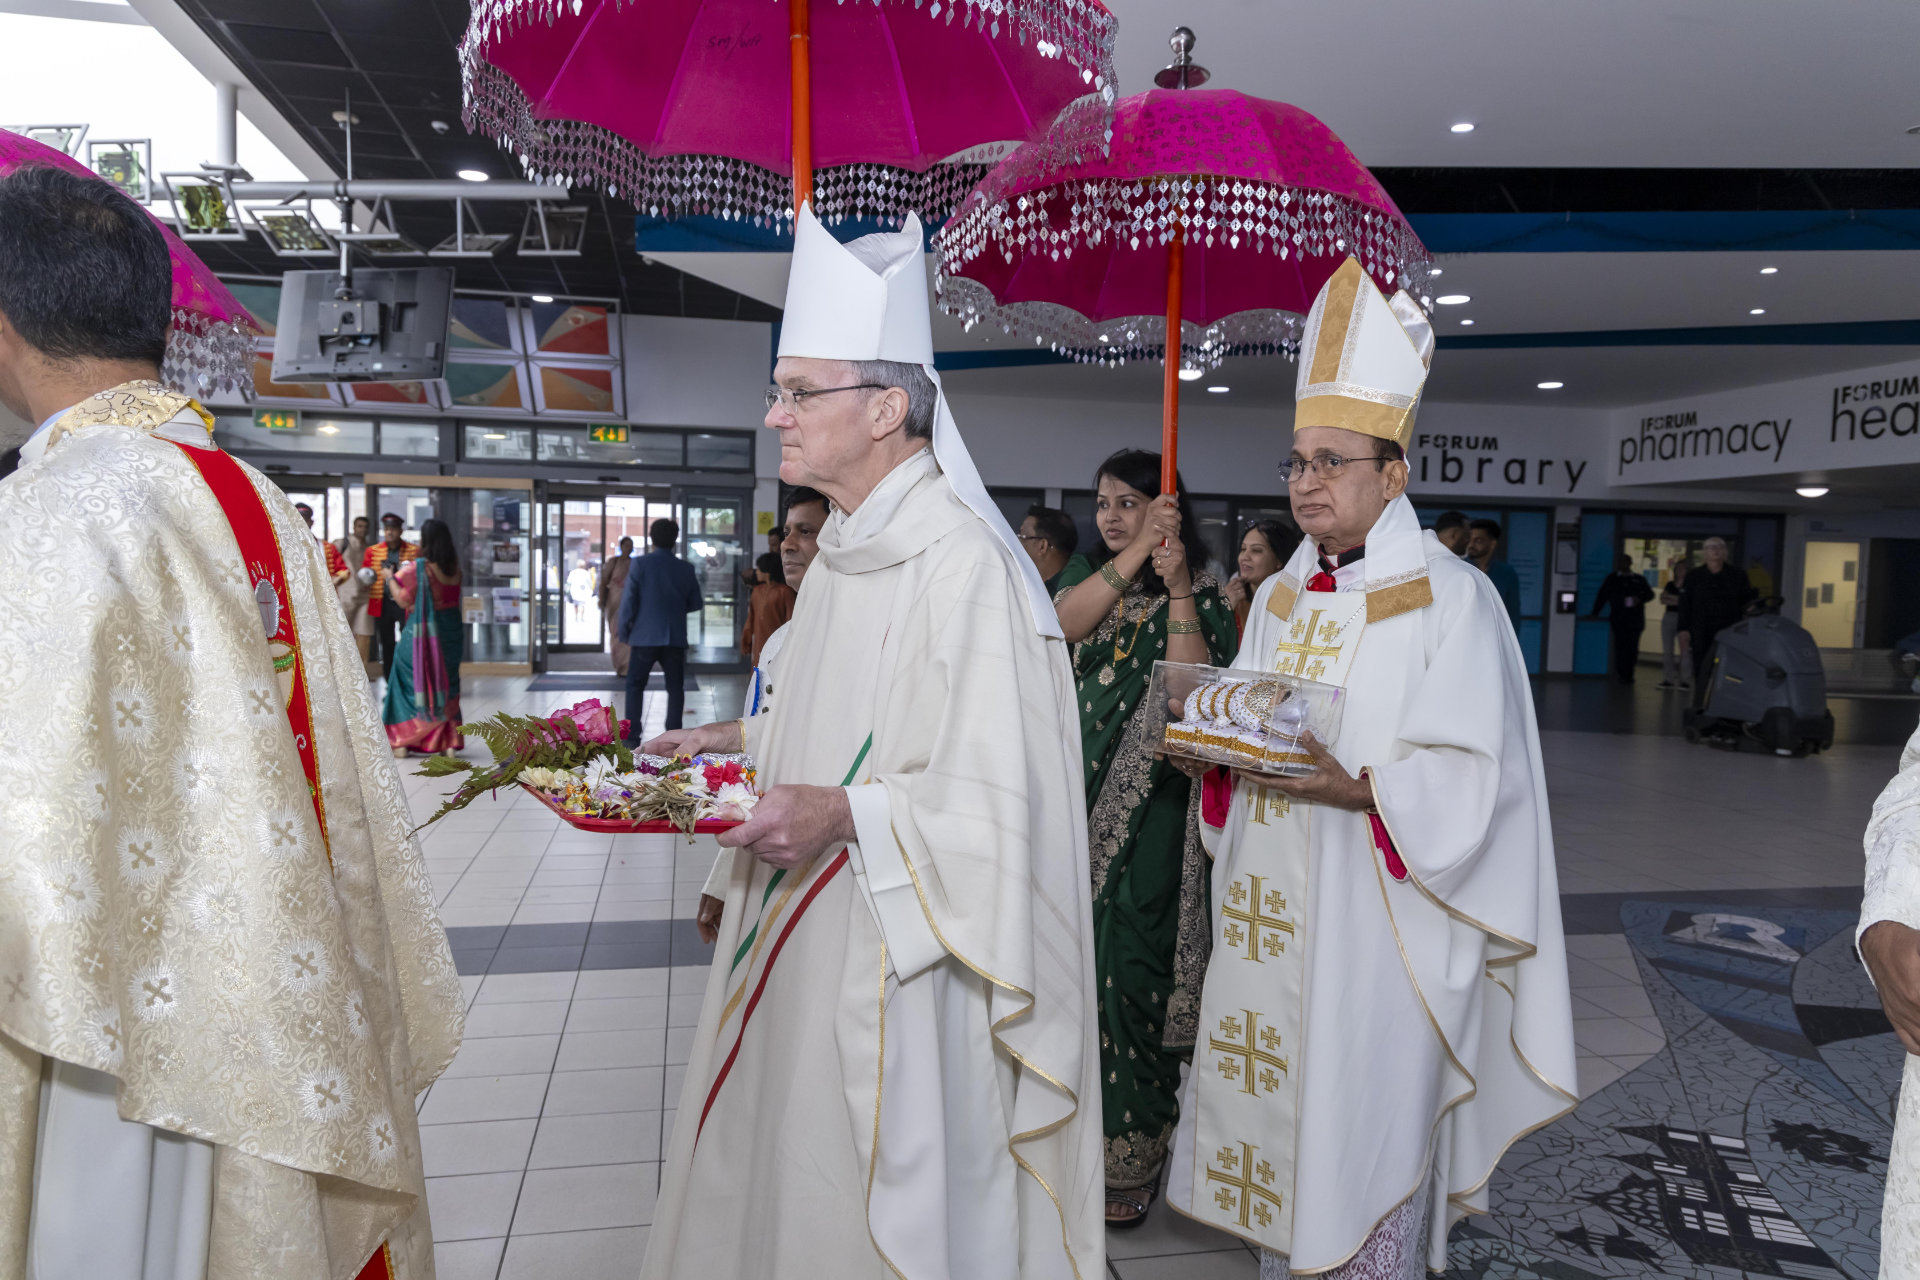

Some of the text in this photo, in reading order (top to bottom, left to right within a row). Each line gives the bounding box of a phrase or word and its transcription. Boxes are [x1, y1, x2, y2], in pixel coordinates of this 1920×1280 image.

[1841, 376, 1920, 404] FORUM
[1646, 411, 1698, 432] FORUM
[1830, 387, 1920, 443] hea
[1418, 434, 1499, 451] FORUM
[1618, 418, 1793, 476] pharmacy
[1420, 449, 1588, 493] ibrary
